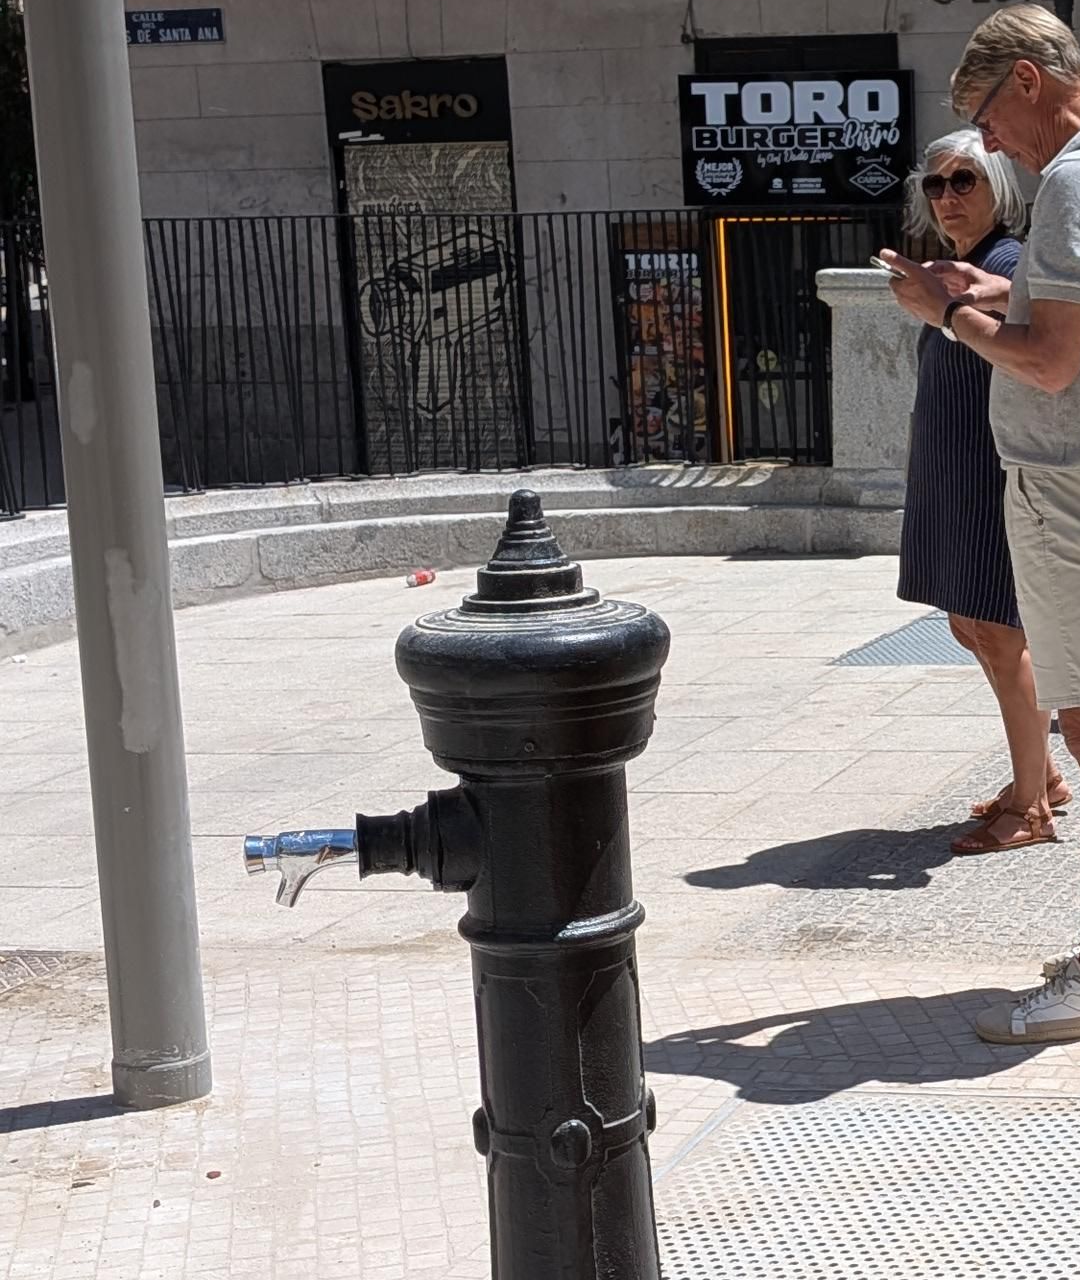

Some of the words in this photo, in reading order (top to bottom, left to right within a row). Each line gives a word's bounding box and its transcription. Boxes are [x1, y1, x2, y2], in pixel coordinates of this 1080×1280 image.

[132, 13, 165, 22] CALLE
[137, 29, 151, 43] DE
[159, 28, 192, 42] SANTA
[198, 27, 219, 41] ANA
[351, 90, 478, 122] Sakro
[690, 79, 900, 125] TORO
[692, 126, 848, 152] BURGER
[843, 117, 900, 151] Bistró
[704, 163, 734, 171] MEJOR
